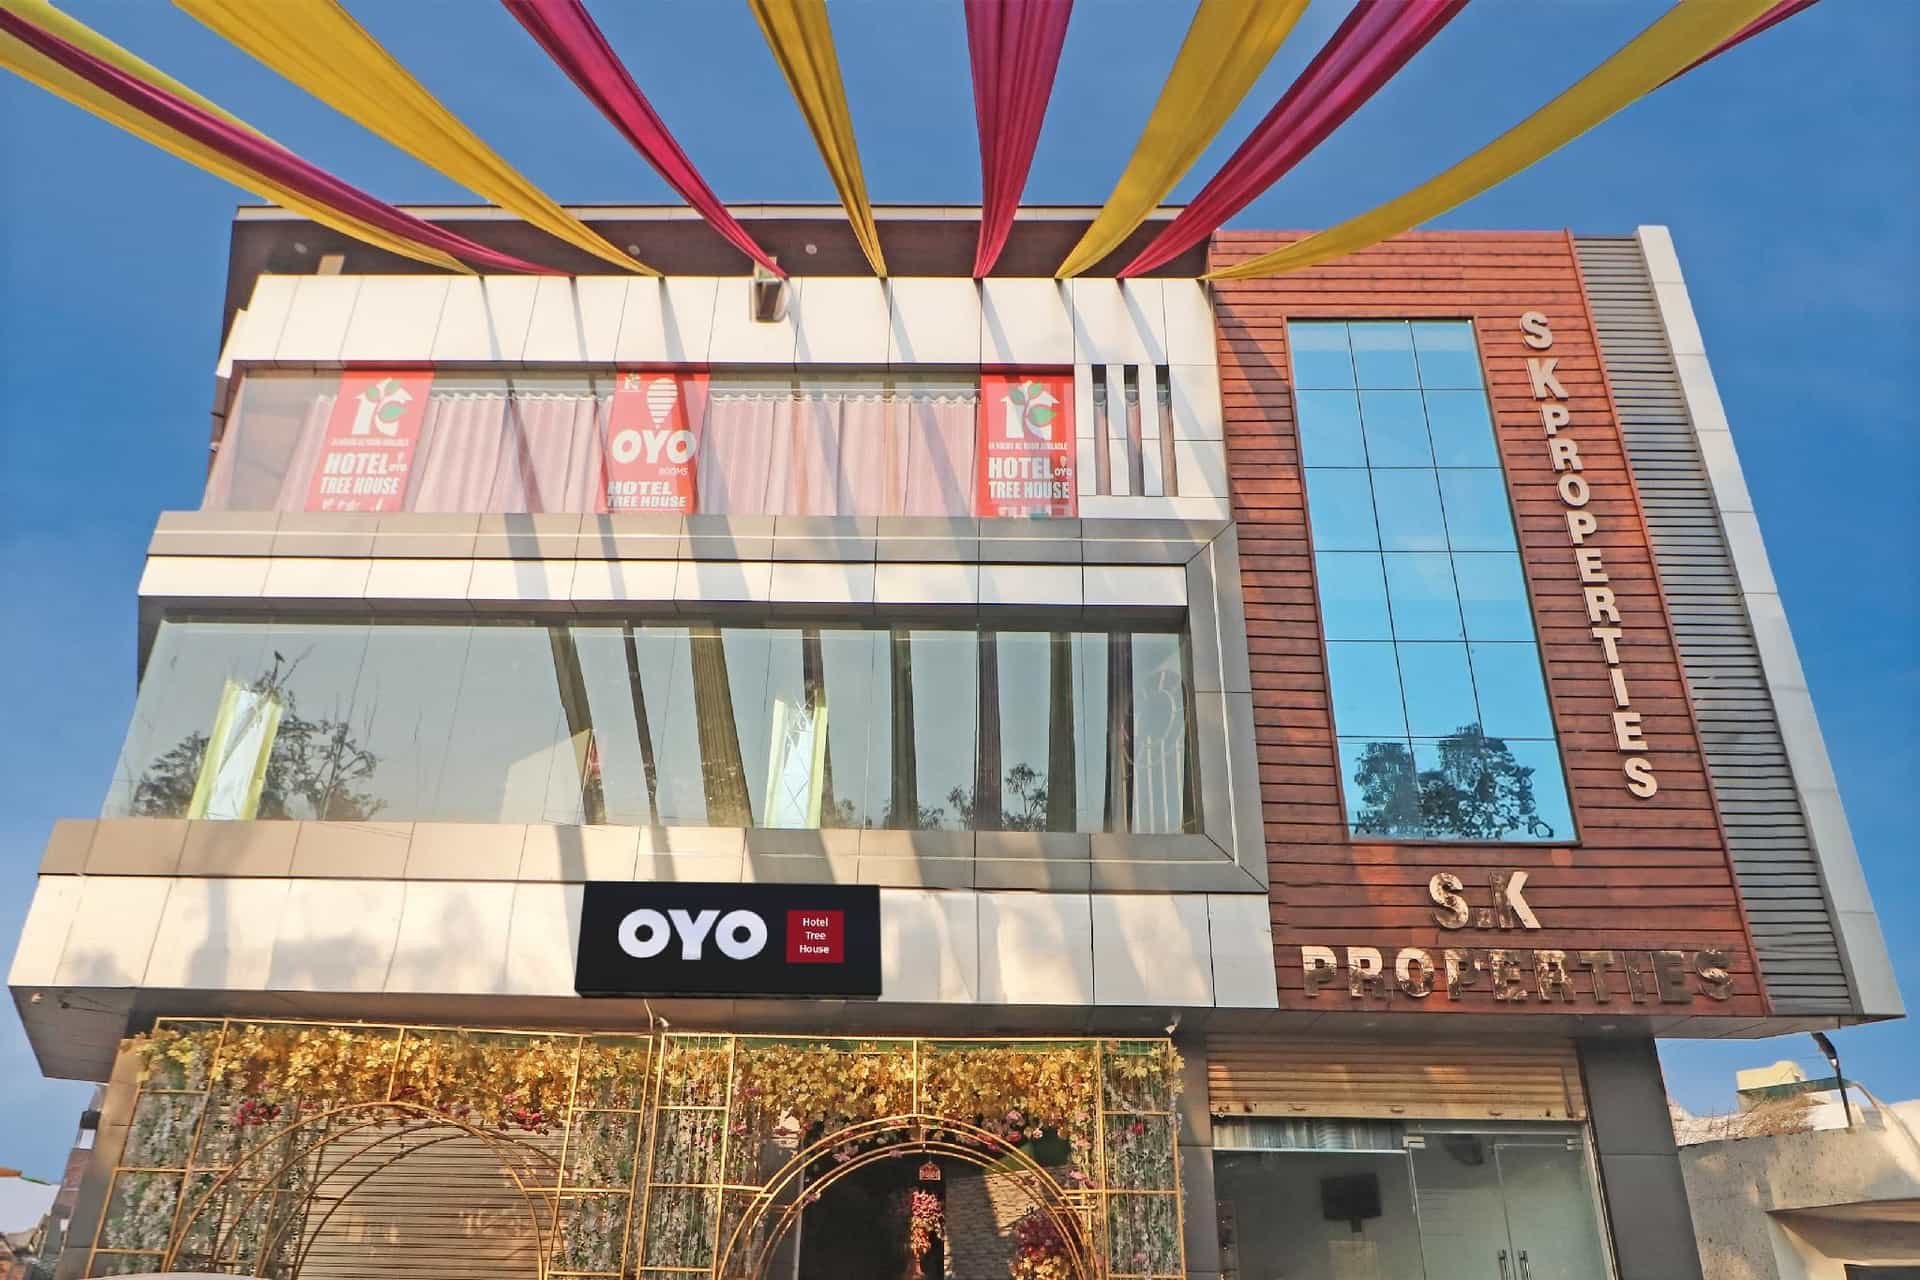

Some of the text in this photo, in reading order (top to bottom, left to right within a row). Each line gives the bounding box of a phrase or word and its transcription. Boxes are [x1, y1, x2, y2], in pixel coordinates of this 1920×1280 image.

[612, 429, 697, 464] OYO
[324, 452, 388, 475] HOTEL
[988, 456, 1072, 479] HOTEL OYO
[320, 476, 400, 496] TREE HOUSE
[608, 480, 672, 495] HOTEL
[988, 480, 1070, 499] TREE HOUSE
[607, 495, 687, 508] TREE HOUSE
[1540, 403, 1658, 798] PROPERTIES
[802, 917, 829, 928] Hotel
[618, 908, 768, 960] OYO
[805, 931, 826, 940] Tree
[799, 944, 830, 954] House
[1300, 944, 1736, 1004] PROPERTIES
